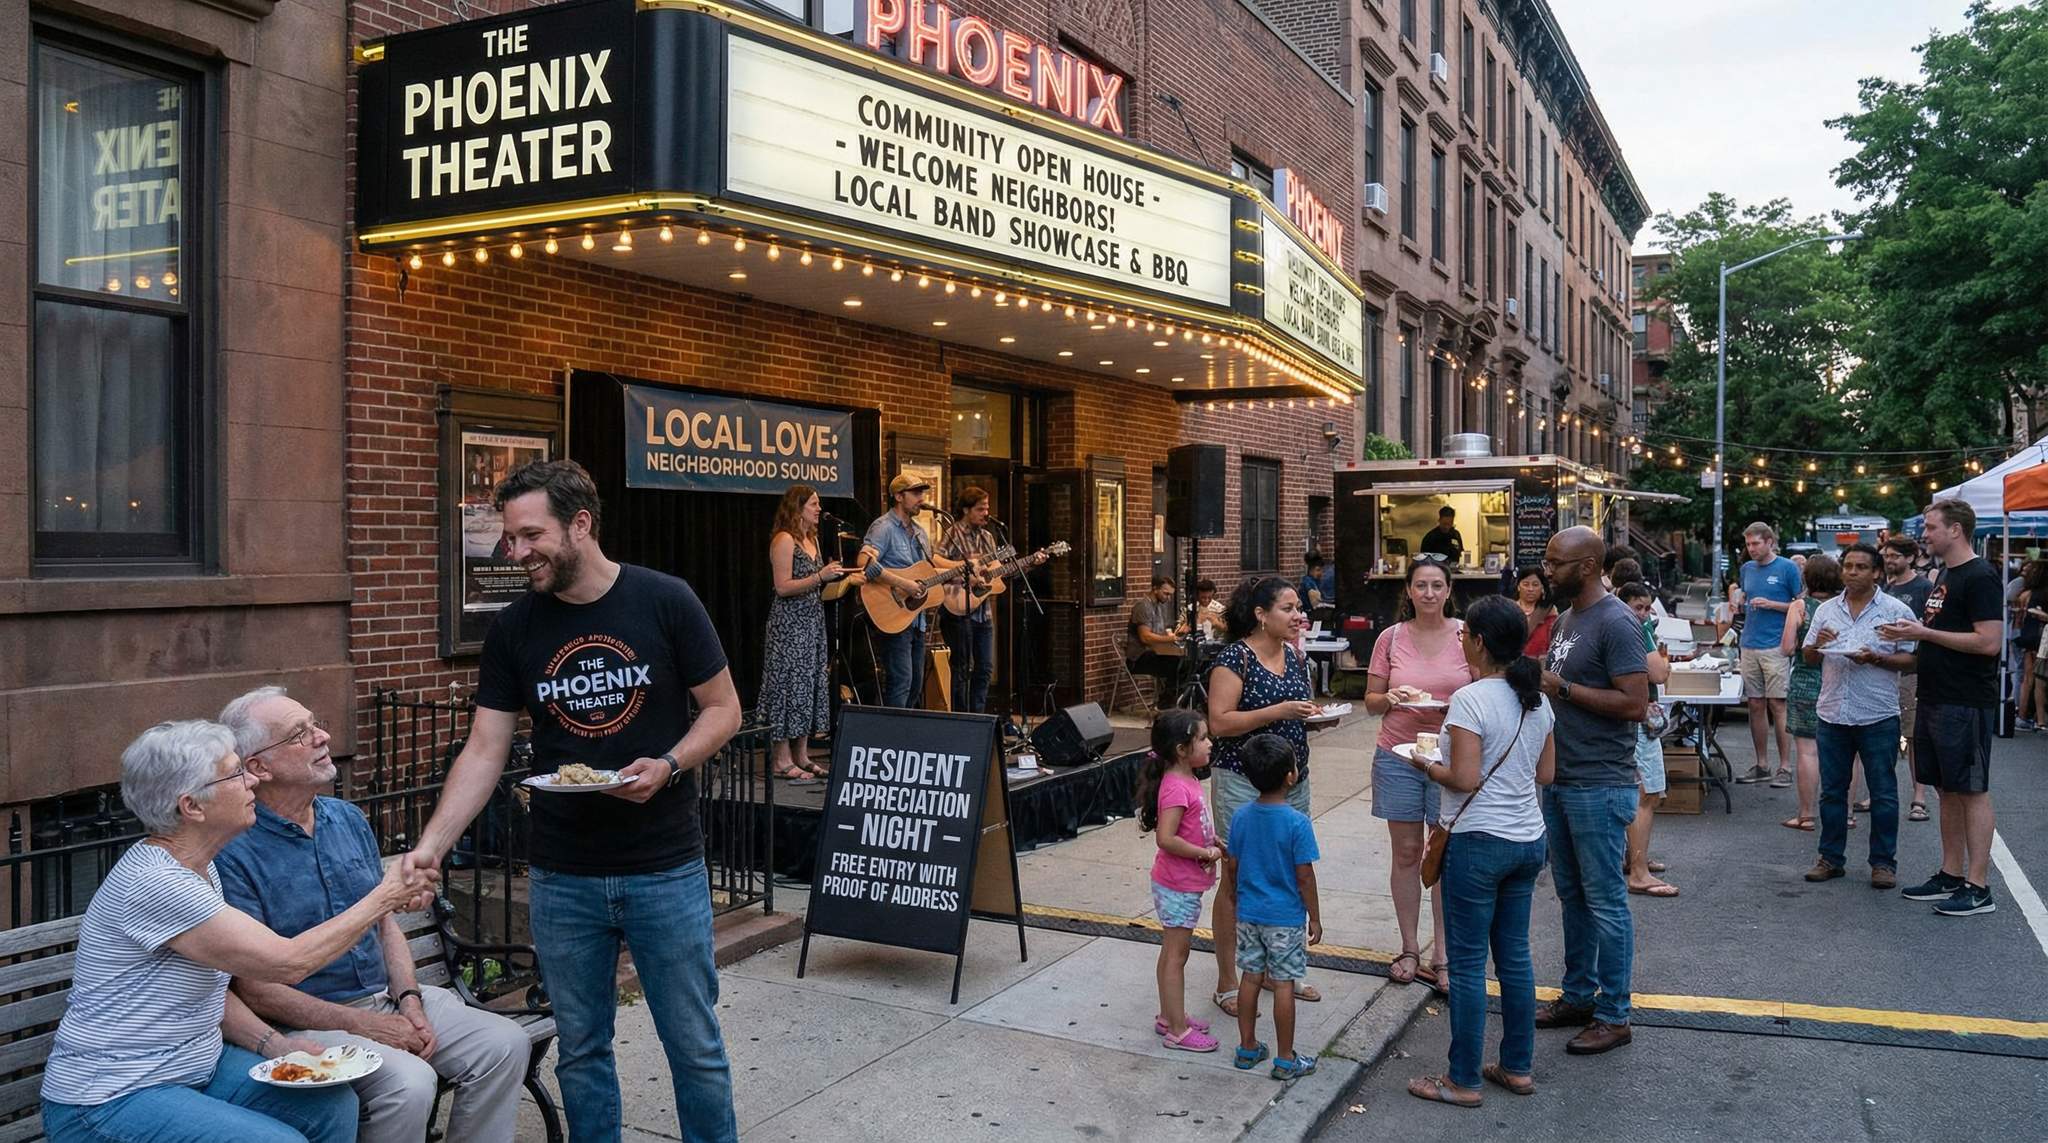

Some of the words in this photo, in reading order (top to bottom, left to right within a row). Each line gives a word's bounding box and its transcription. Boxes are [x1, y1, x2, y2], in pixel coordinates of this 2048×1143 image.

[483, 24, 529, 58] THE
[867, 0, 1123, 134] PHOENIX
[404, 49, 612, 135] PHOENIX
[402, 120, 613, 200] THEATER
[858, 94, 1005, 165] COMMUNITY
[1017, 144, 1071, 186] OPEN
[1083, 163, 1145, 208] HOUSE
[858, 134, 978, 197] WELCOME
[991, 172, 1115, 234] NEIGHBORS!
[835, 170, 918, 221] LOCAL
[934, 196, 996, 239] BAND
[1009, 216, 1120, 270] SHOWCASE
[1130, 247, 1142, 275] &
[1152, 253, 1189, 287] BBQ
[1286, 168, 1344, 271] PHOENIX
[1283, 300, 1301, 331] LOCAL
[646, 406, 752, 452] LOCAL
[760, 419, 839, 461] LOVE:
[647, 452, 777, 479] NEIGHBORHOOD
[780, 462, 838, 482] SOUNDS
[536, 664, 652, 702] PHOENIX
[577, 657, 605, 672] THE
[566, 692, 625, 711] THEATER
[848, 746, 970, 788] RESIDENT
[837, 781, 971, 819] APPRECIATION
[860, 813, 938, 853] NIGHT
[831, 852, 867, 875] FREE
[869, 857, 916, 882] ENTRY
[919, 862, 957, 887] WITH
[822, 875, 868, 899] PROOF
[870, 881, 890, 902] OF
[891, 884, 959, 912] ADDRESS
